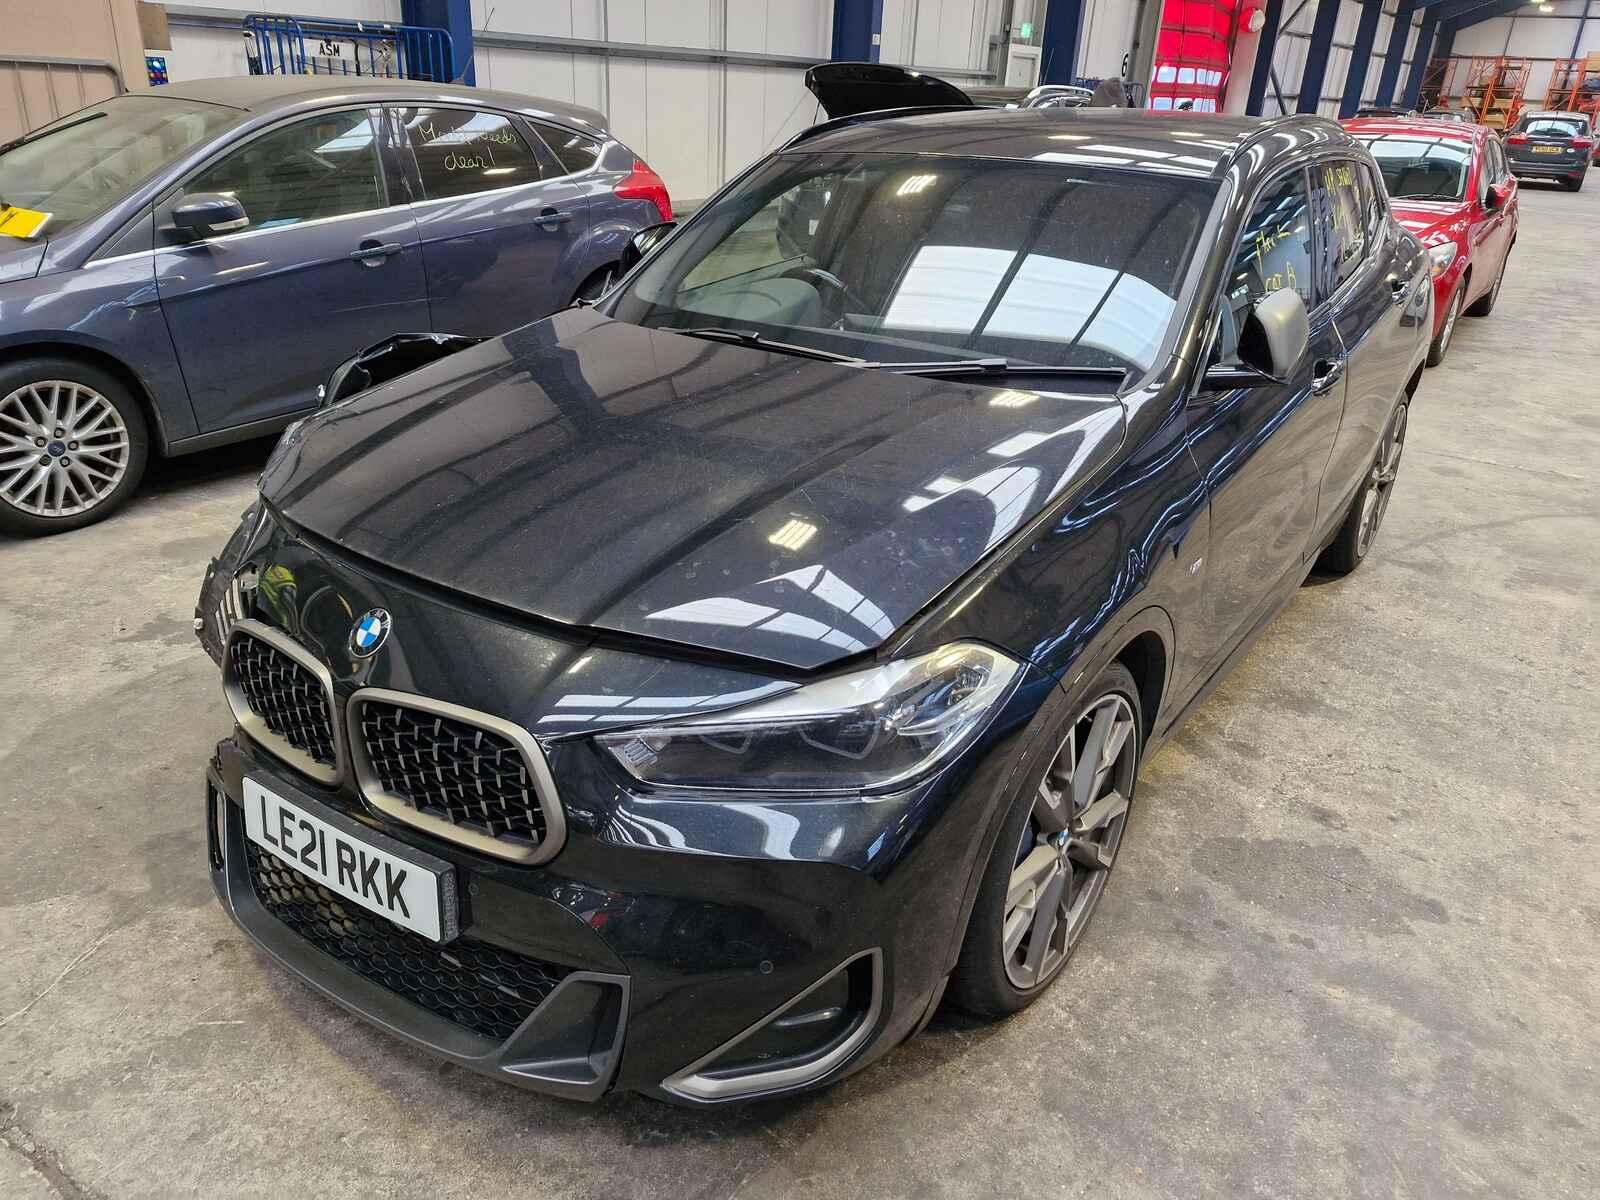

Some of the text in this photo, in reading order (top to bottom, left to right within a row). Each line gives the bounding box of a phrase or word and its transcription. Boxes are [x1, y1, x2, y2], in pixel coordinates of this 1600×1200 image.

[319, 42, 340, 57] ASM
[260, 795, 411, 919] LE21 RKK
